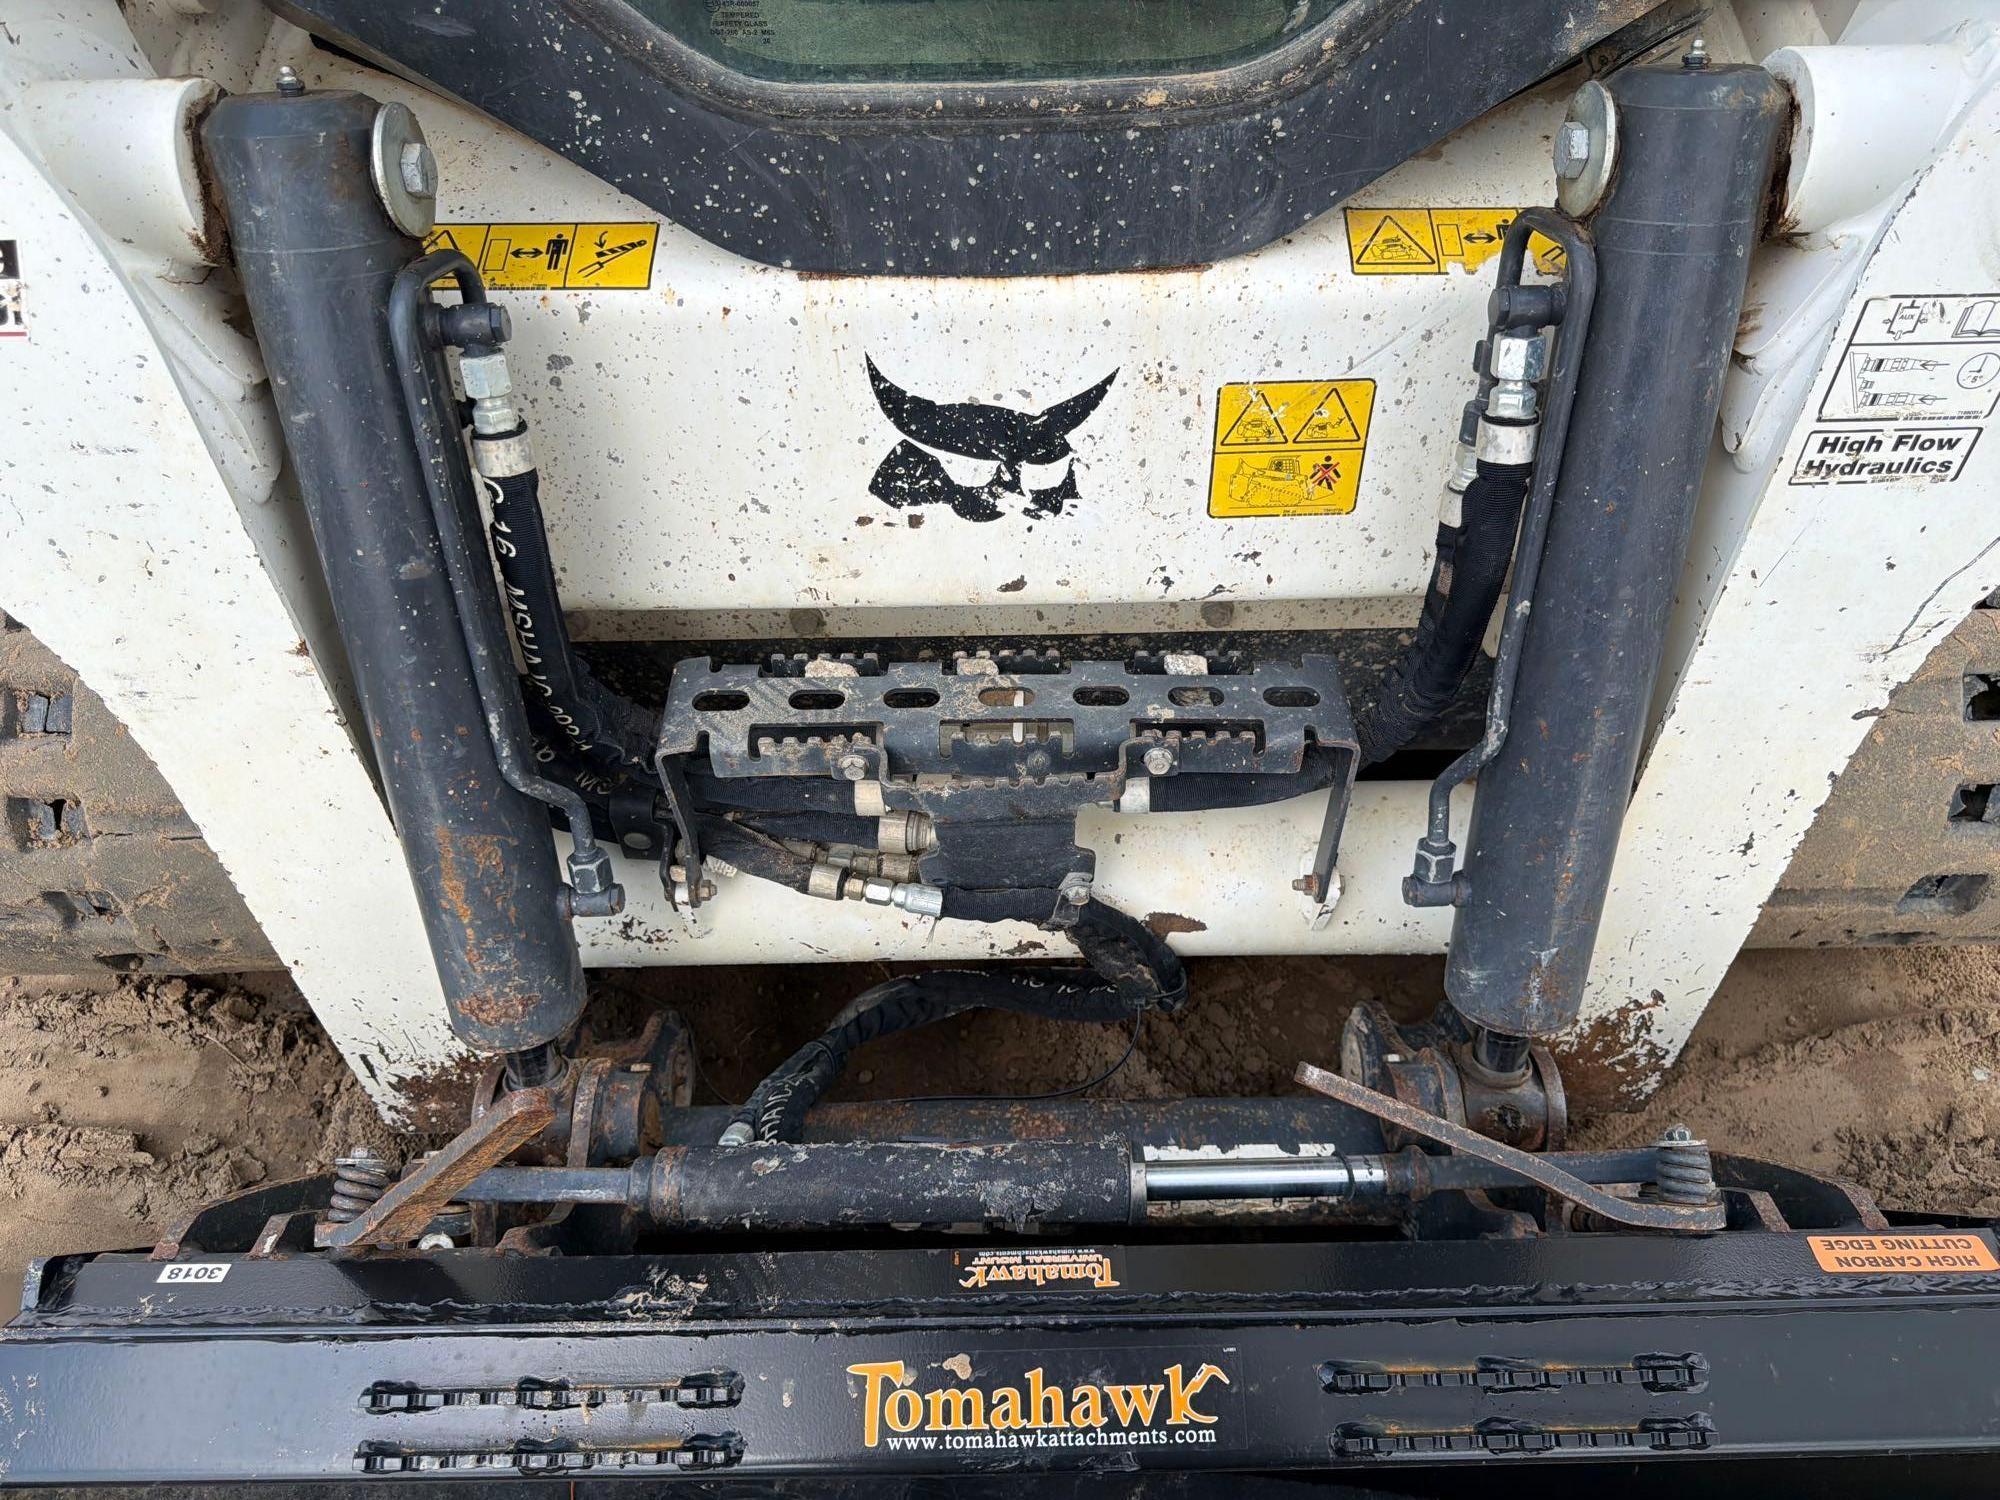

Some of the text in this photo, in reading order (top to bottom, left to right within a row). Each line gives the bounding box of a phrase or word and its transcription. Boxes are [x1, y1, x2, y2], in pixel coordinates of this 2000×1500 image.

[1899, 313, 1915, 321] AUX
[1816, 433, 1962, 457] High Flow
[1803, 457, 1953, 480] Hydraulics
[1820, 1238, 1973, 1250] CUTTING EDGE
[971, 1254, 1023, 1266] MOUNT
[1026, 1253, 1103, 1264] UNIVERSAL
[1835, 1255, 1981, 1268] HIGH CARBON
[167, 1267, 223, 1280] 3018
[887, 1428, 1217, 1451] www.tomahawkattachments.com
